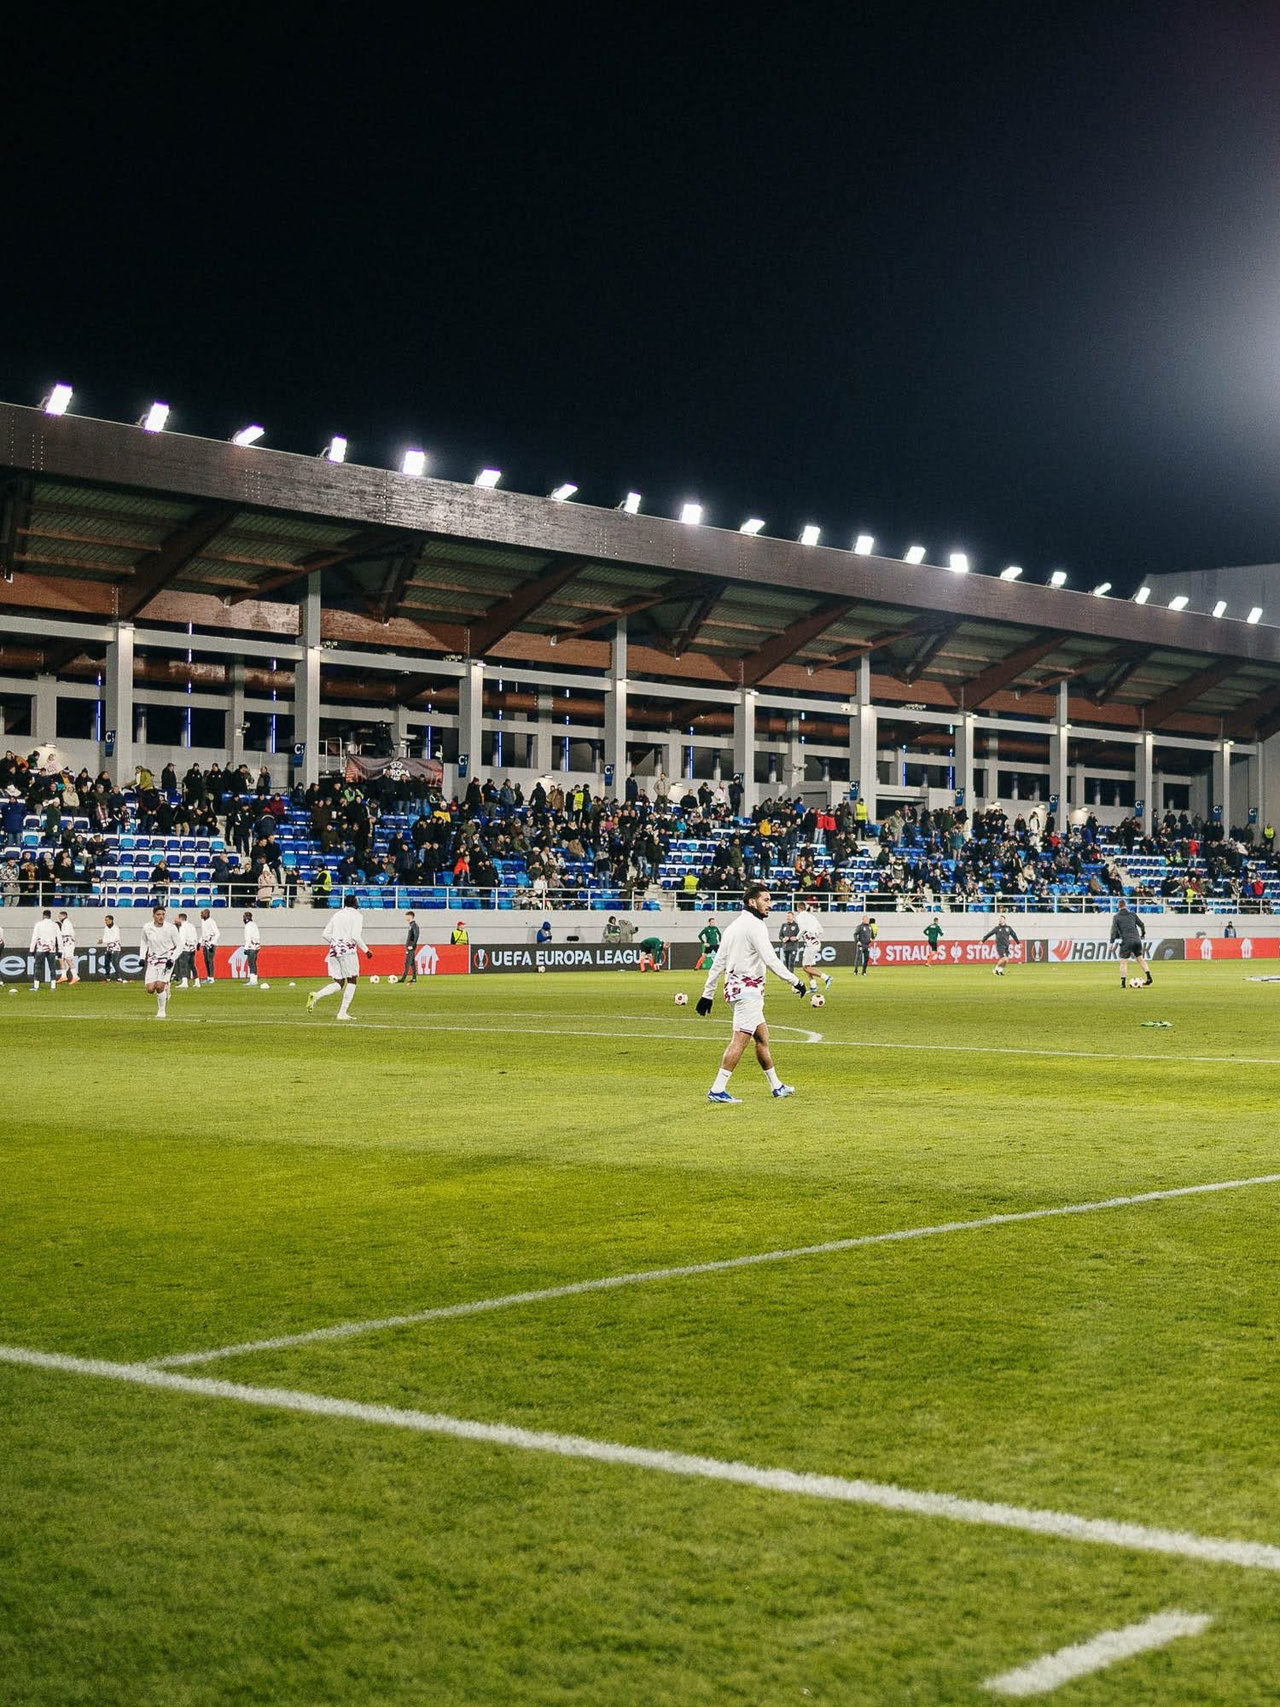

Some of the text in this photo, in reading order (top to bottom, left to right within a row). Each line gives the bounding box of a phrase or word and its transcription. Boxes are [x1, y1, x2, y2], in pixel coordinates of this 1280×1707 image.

[491, 949, 649, 966] UEFA EUROPA LEAGU
[885, 944, 1022, 961] STRAUS STRASS
